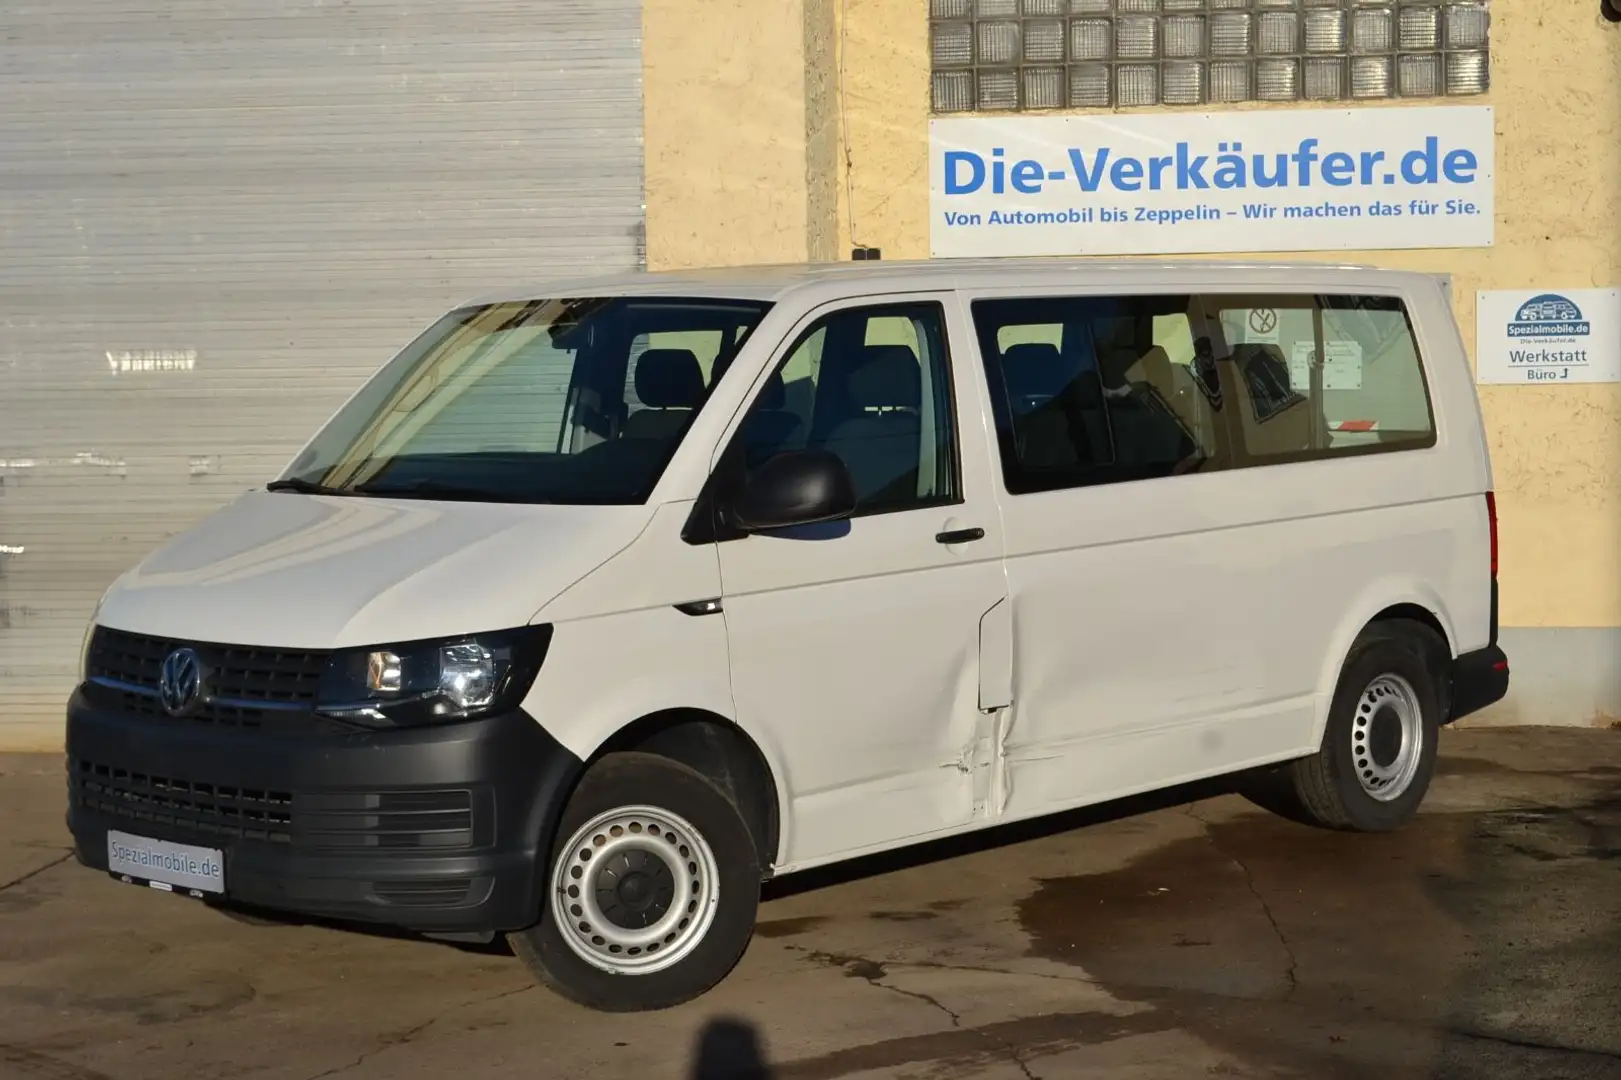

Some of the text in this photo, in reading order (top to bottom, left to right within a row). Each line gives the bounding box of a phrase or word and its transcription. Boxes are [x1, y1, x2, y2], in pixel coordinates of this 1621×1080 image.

[944, 136, 1478, 195] Die-Verkäufer.de
[944, 211, 981, 226] Von
[988, 207, 1093, 225] Automobil
[1100, 207, 1128, 223] bis
[1135, 205, 1220, 224] Zeppelin
[1243, 203, 1277, 219] Wir
[1284, 202, 1361, 218] machen
[1368, 200, 1402, 216] das
[1409, 200, 1439, 215] für
[1445, 199, 1481, 215] Sie.
[1508, 323, 1589, 335] Spezialmobile.de
[1509, 349, 1587, 363] Werkstatt
[1527, 368, 1556, 380] Büro
[111, 840, 219, 877] Spezialmobile.de
